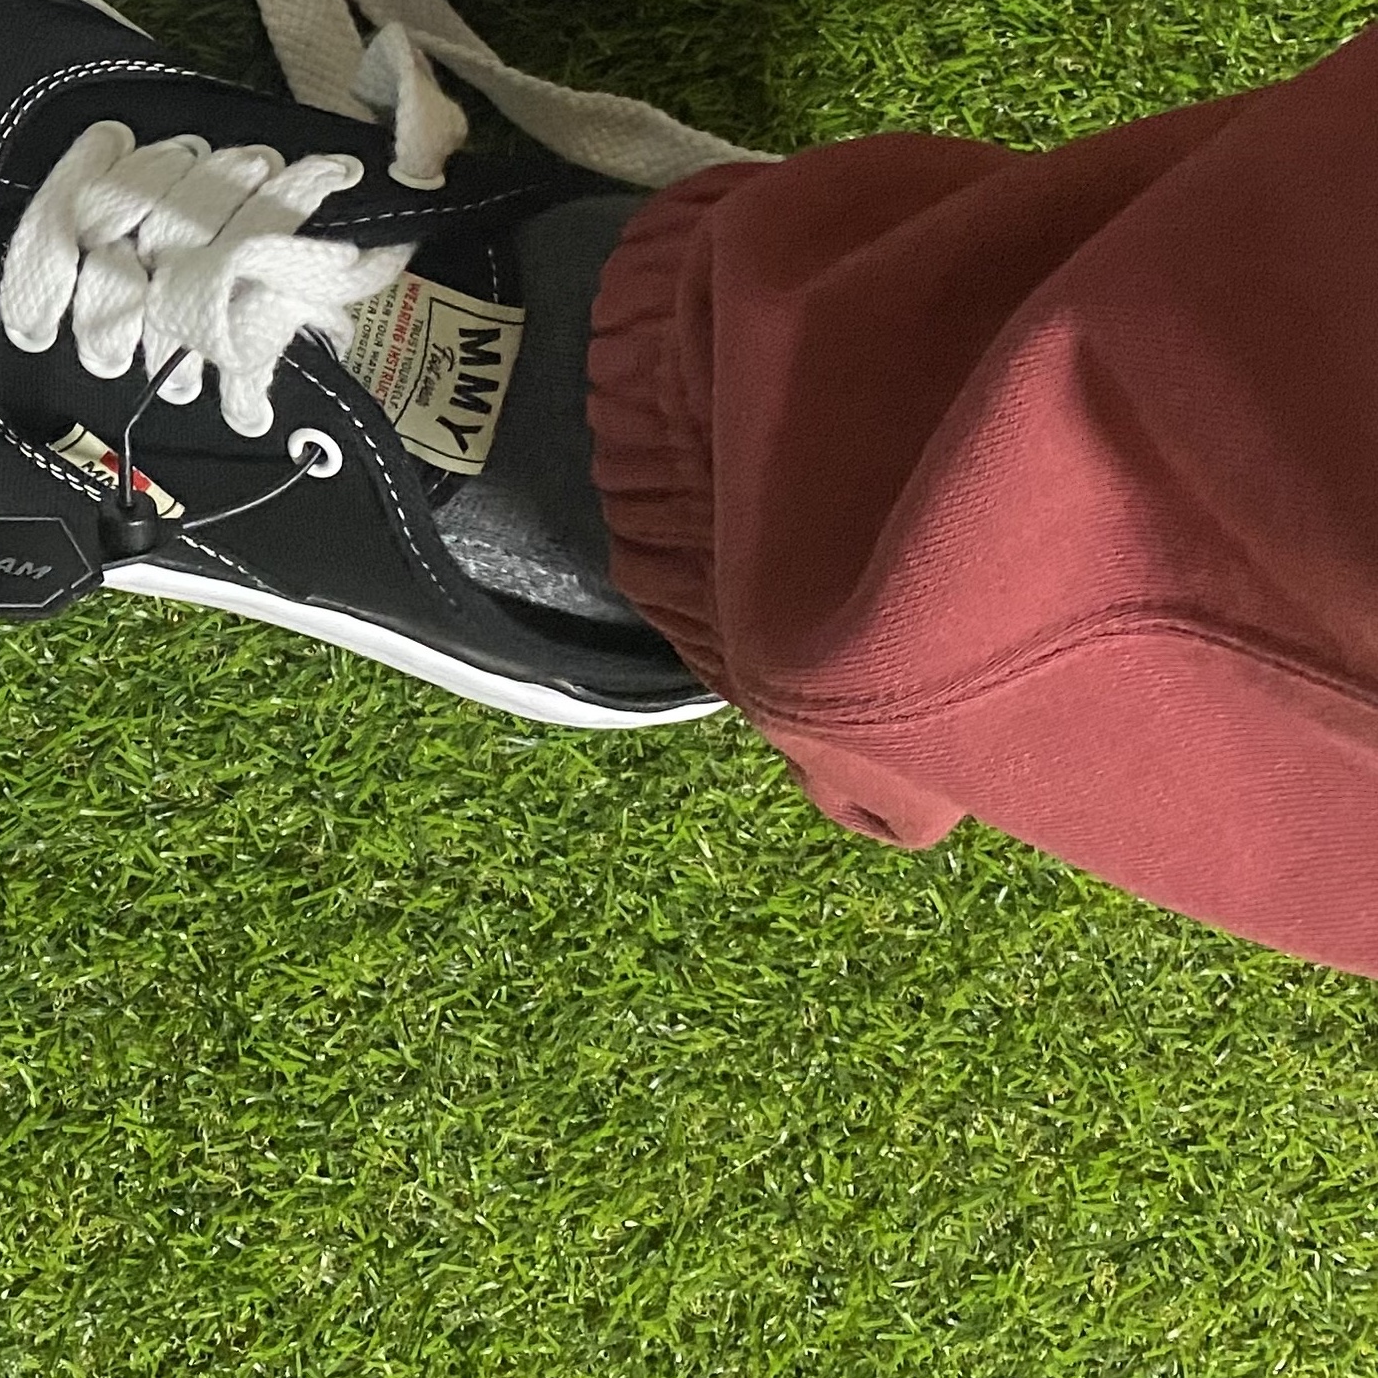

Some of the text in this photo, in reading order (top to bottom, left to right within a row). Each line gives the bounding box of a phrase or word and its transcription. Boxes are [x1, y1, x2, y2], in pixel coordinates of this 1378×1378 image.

[356, 317, 374, 360] FORGET
[392, 283, 421, 343] WEARING
[405, 319, 424, 355] TRUST
[435, 327, 502, 455] MMY
